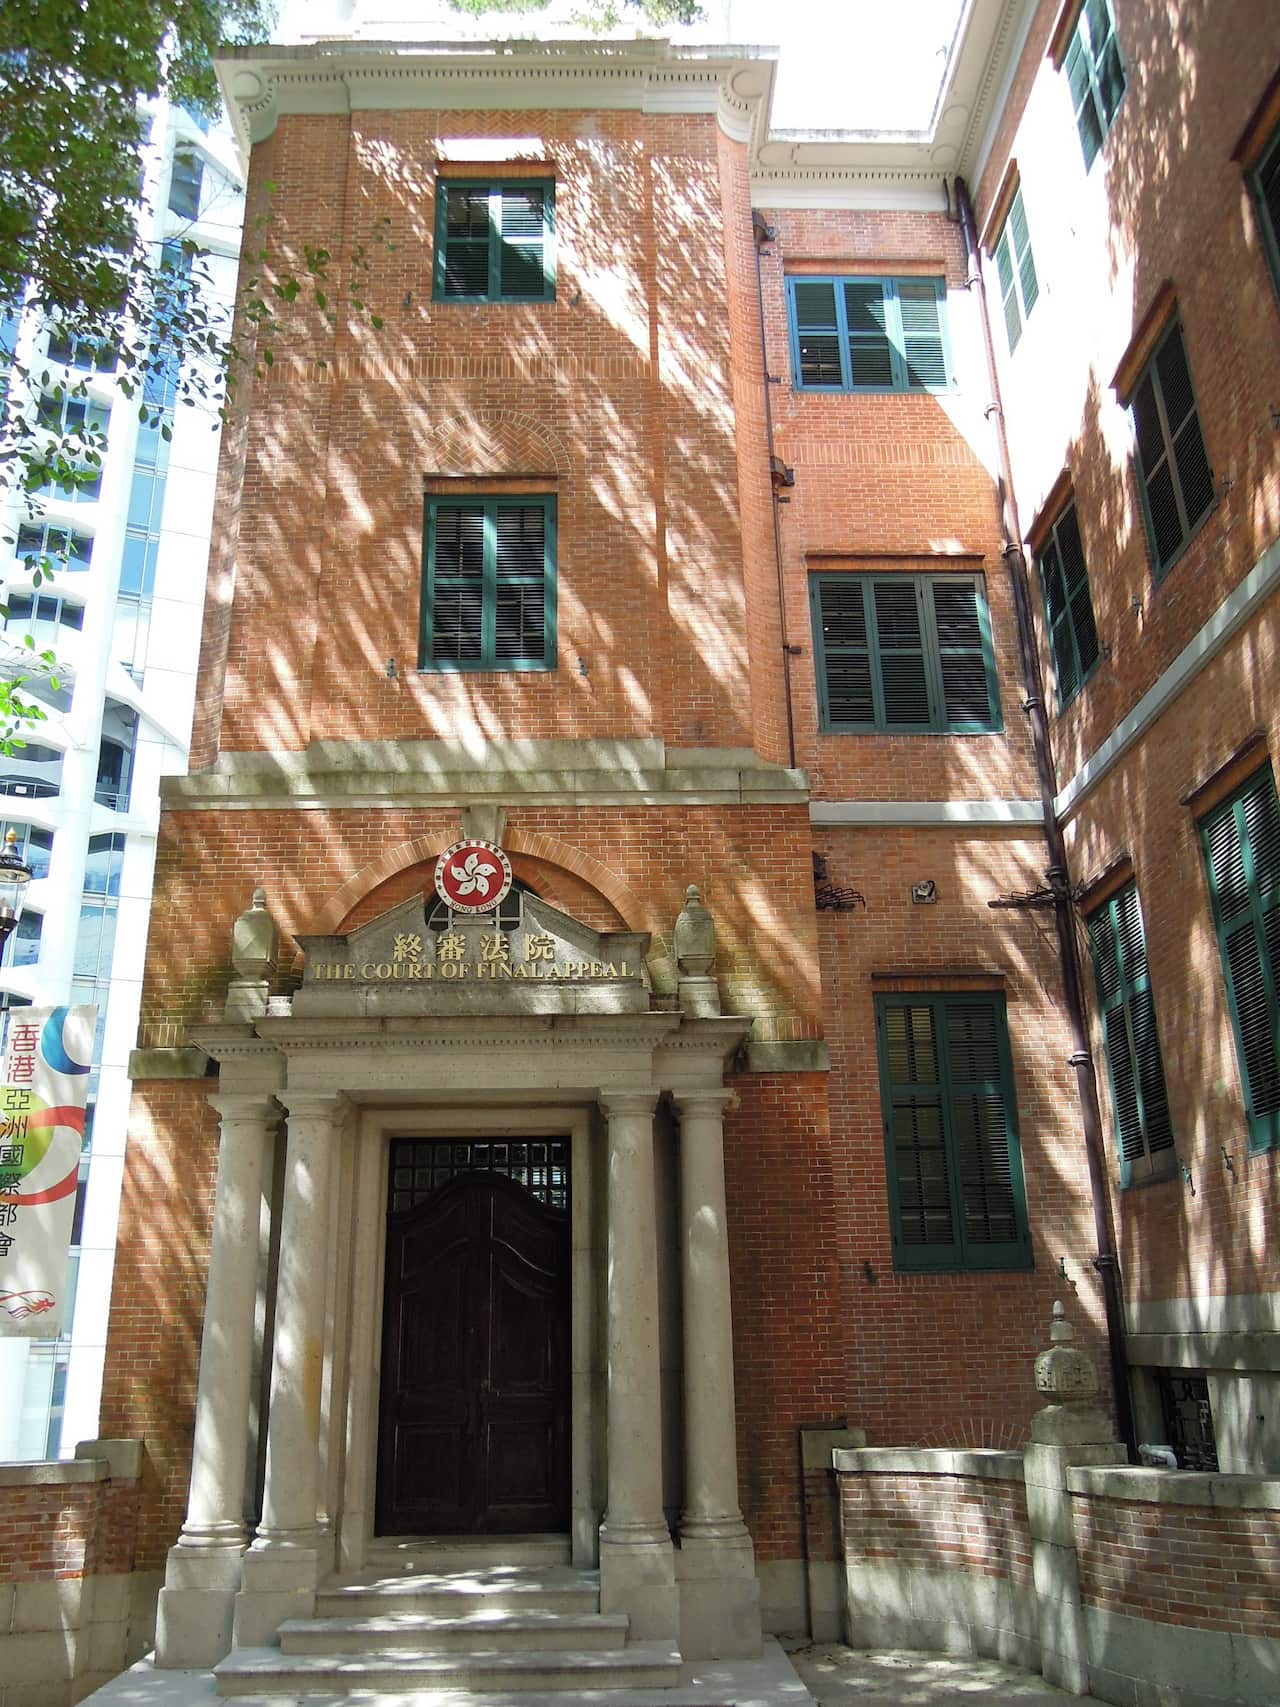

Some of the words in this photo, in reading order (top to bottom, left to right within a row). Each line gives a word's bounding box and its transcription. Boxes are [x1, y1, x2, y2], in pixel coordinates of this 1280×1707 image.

[393, 932, 556, 963] 終審法院
[312, 963, 356, 980] THE
[359, 963, 437, 980] COURT
[441, 962, 472, 979] OF
[476, 961, 544, 978] FINAL
[545, 961, 635, 978] APPEAL
